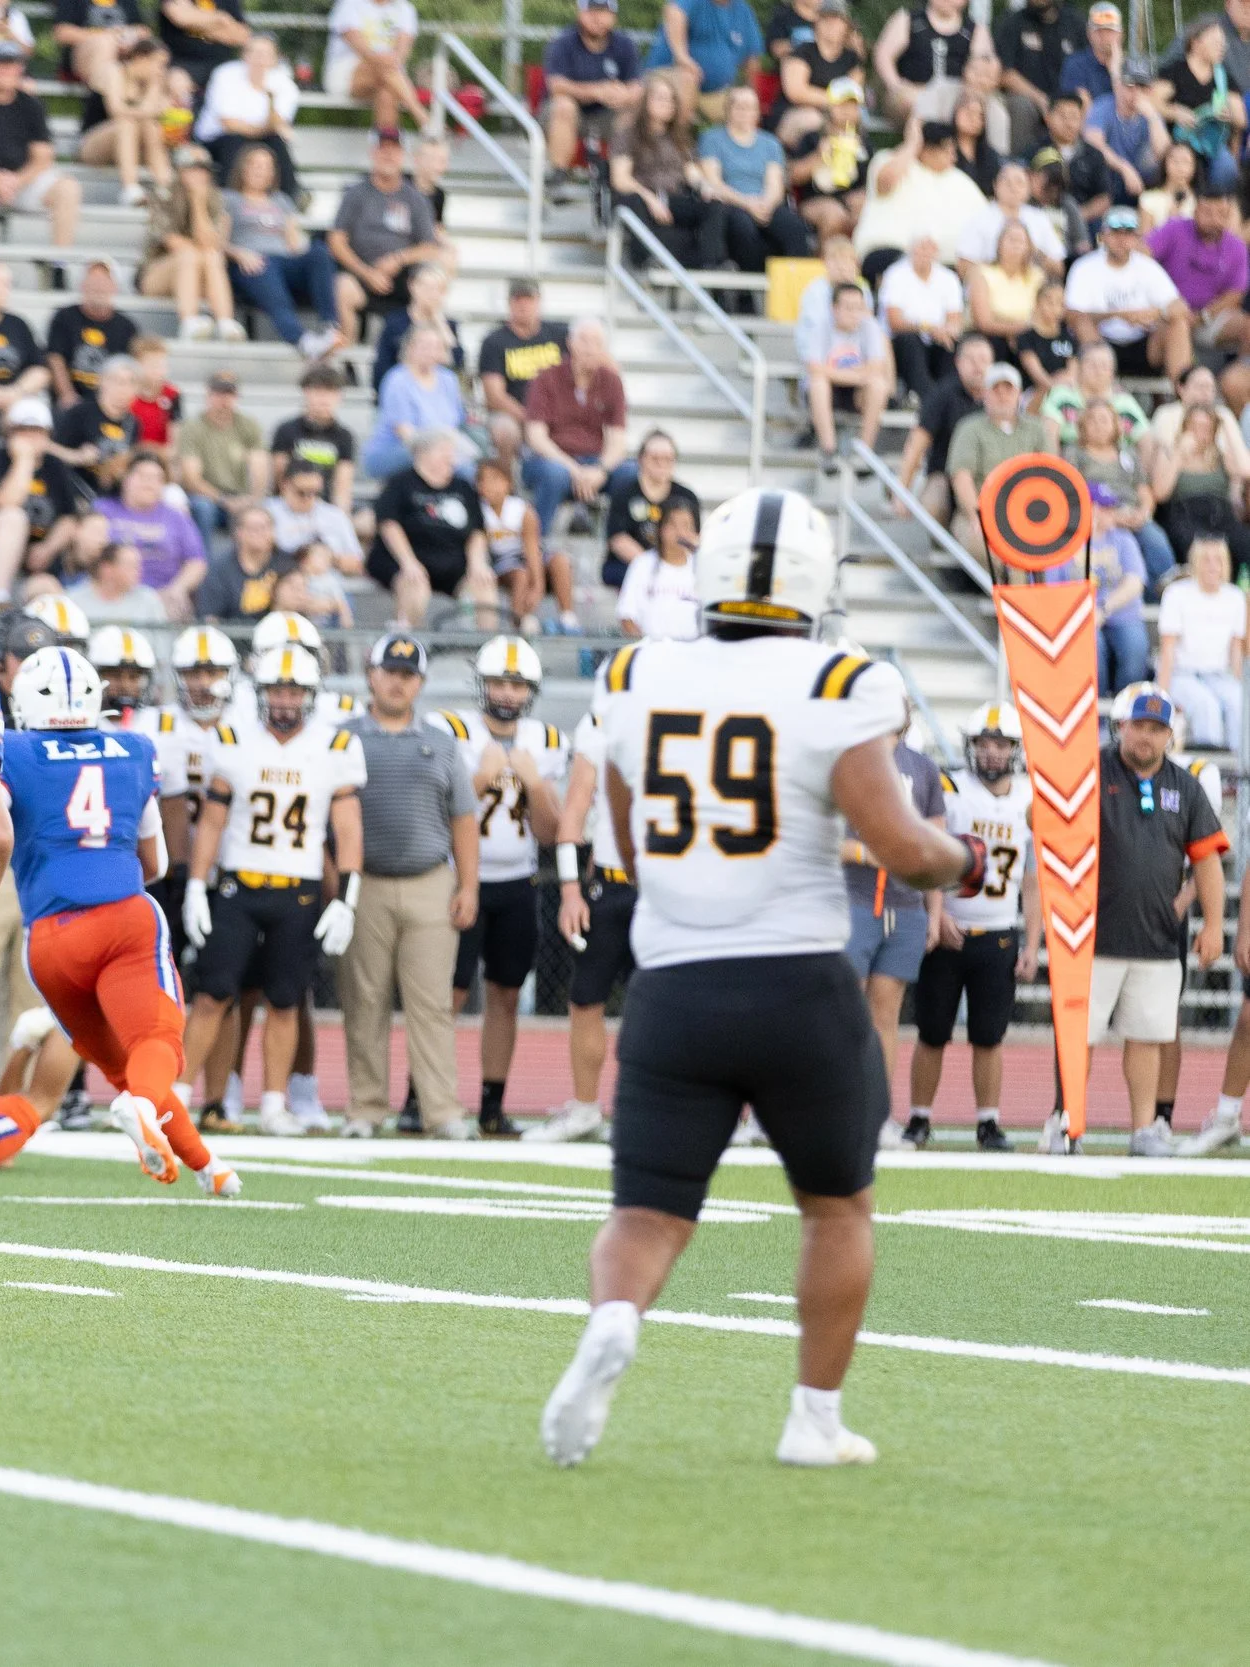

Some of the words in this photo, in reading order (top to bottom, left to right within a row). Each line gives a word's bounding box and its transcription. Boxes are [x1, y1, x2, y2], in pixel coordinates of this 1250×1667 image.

[42, 736, 130, 760] LEA
[66, 765, 111, 848] 4
[249, 790, 308, 849] 24
[644, 709, 778, 860] 59
